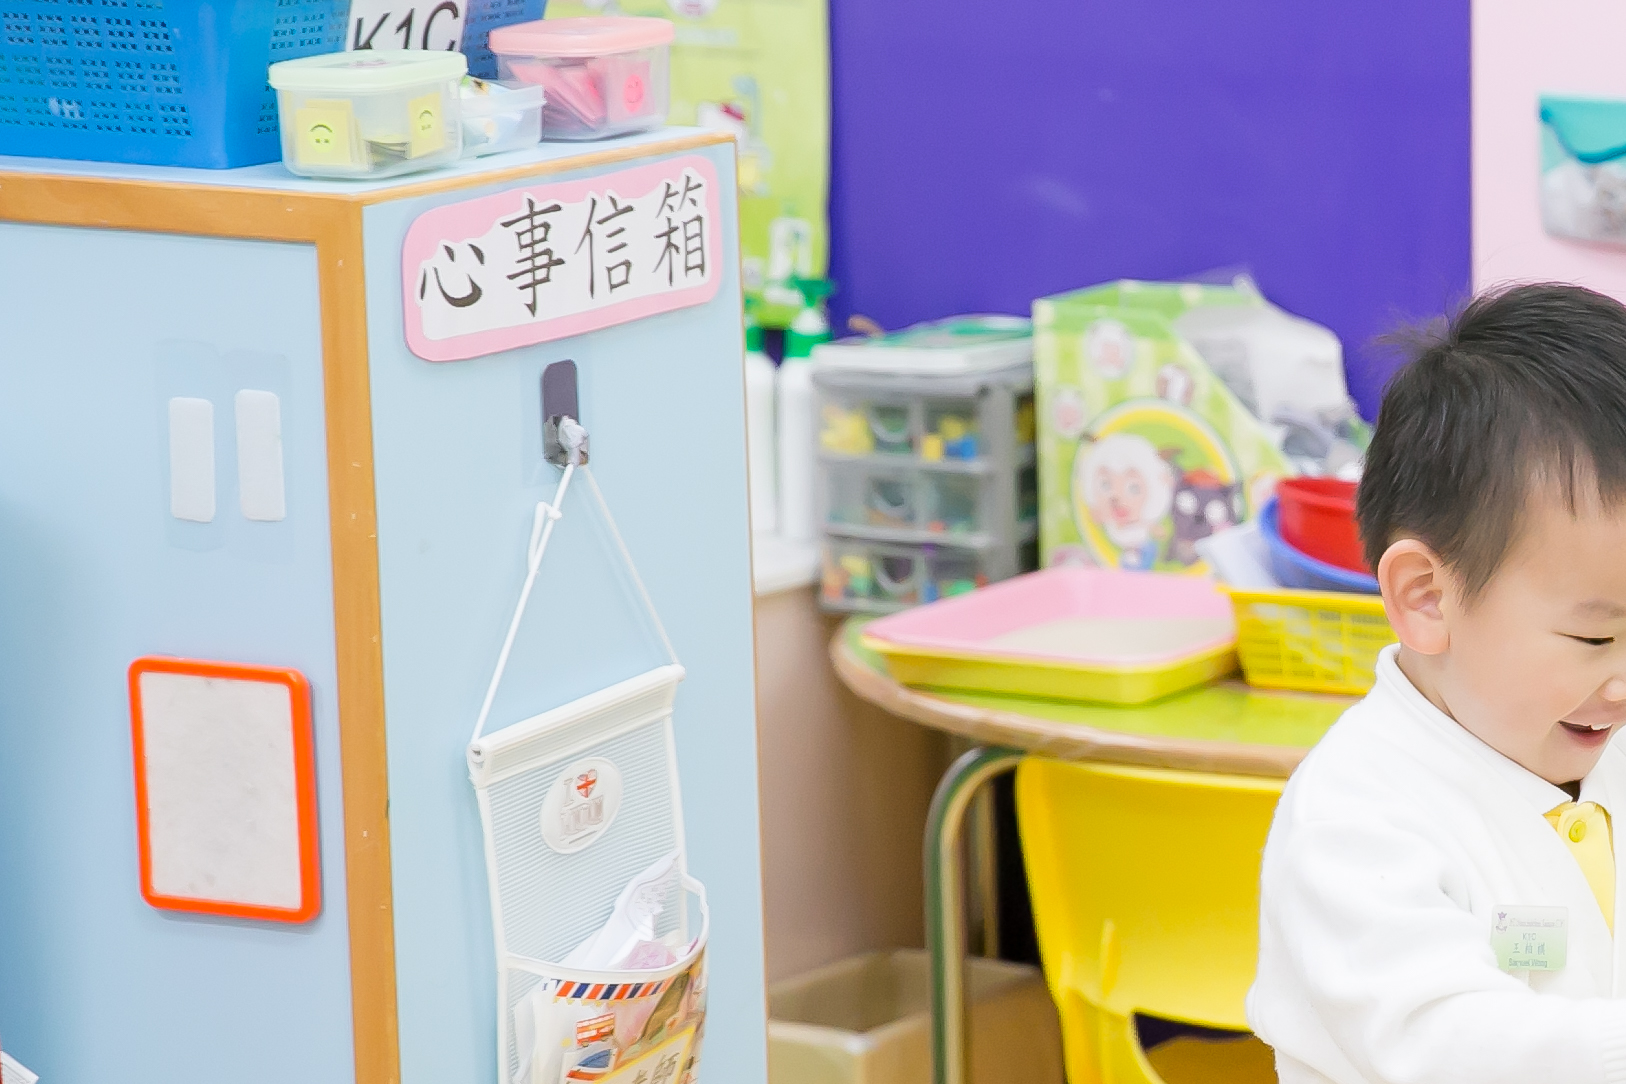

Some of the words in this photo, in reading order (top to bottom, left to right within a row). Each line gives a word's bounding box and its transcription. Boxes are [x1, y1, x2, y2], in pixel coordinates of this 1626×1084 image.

[353, 1, 459, 51] K1C
[419, 174, 705, 318] 心事信箱
